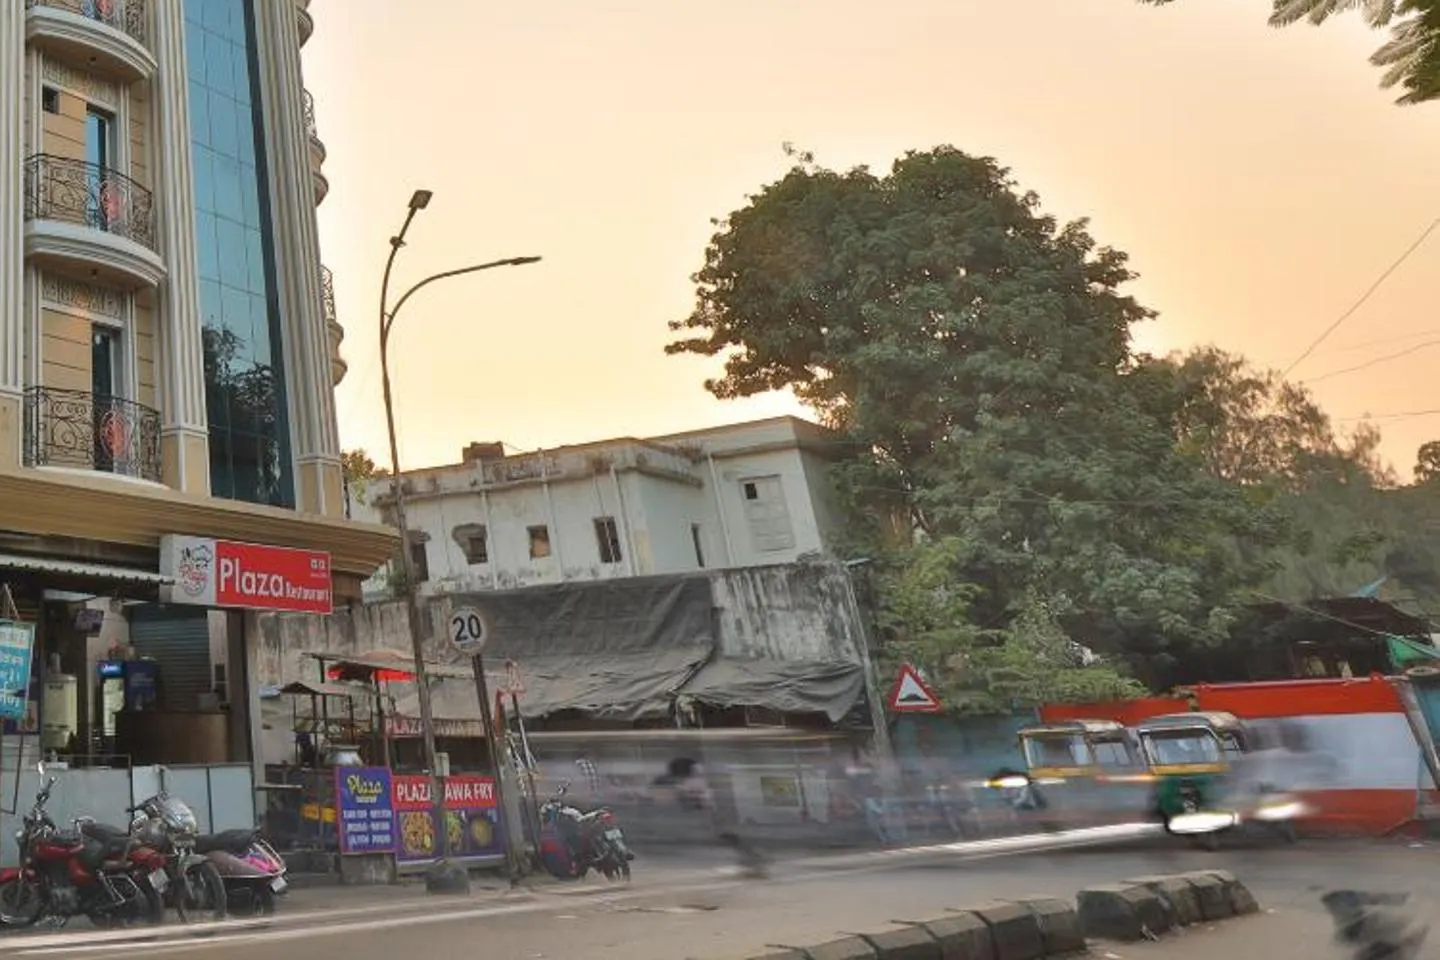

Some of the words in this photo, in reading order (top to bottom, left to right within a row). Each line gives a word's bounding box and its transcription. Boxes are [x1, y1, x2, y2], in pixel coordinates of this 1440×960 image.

[220, 558, 284, 598] Plaza
[452, 613, 482, 642] 20
[474, 782, 493, 801] FRY
